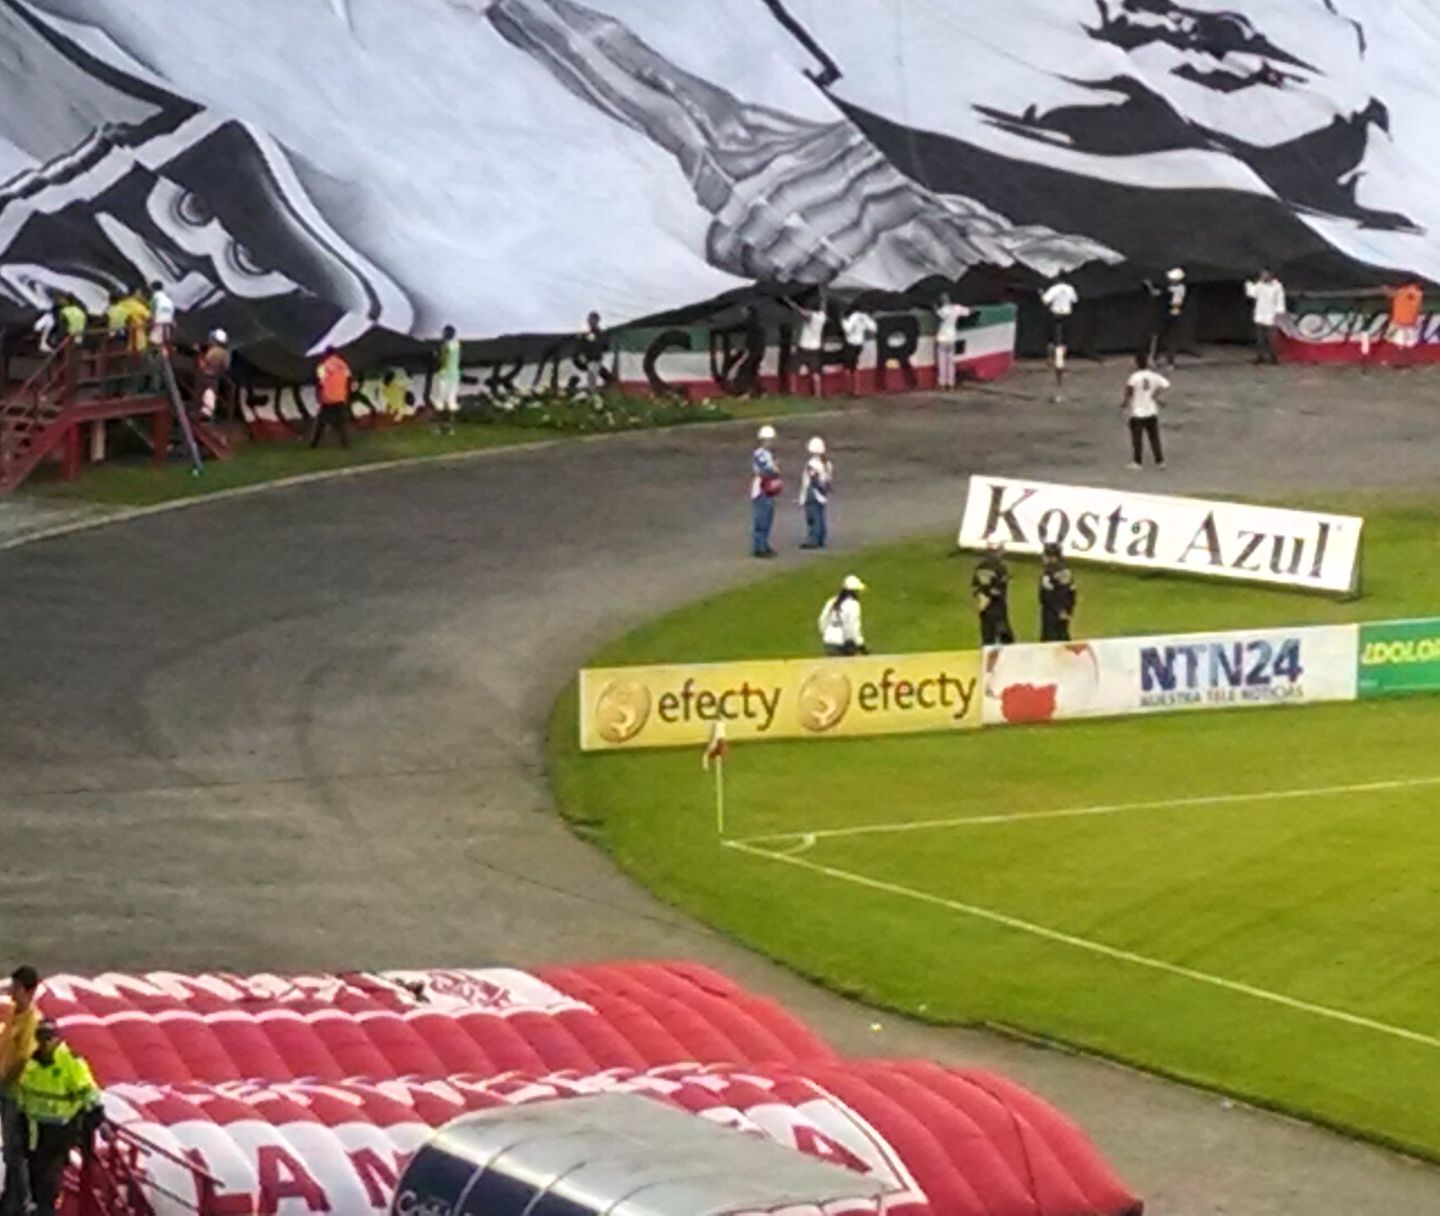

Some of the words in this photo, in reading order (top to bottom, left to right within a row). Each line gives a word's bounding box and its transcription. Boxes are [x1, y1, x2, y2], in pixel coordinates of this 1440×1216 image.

[985, 484, 1159, 561] Kosta
[1182, 511, 1331, 580] Azul
[1140, 638, 1304, 692] NTN24
[659, 682, 782, 731] efecty
[858, 668, 976, 721] efecty
